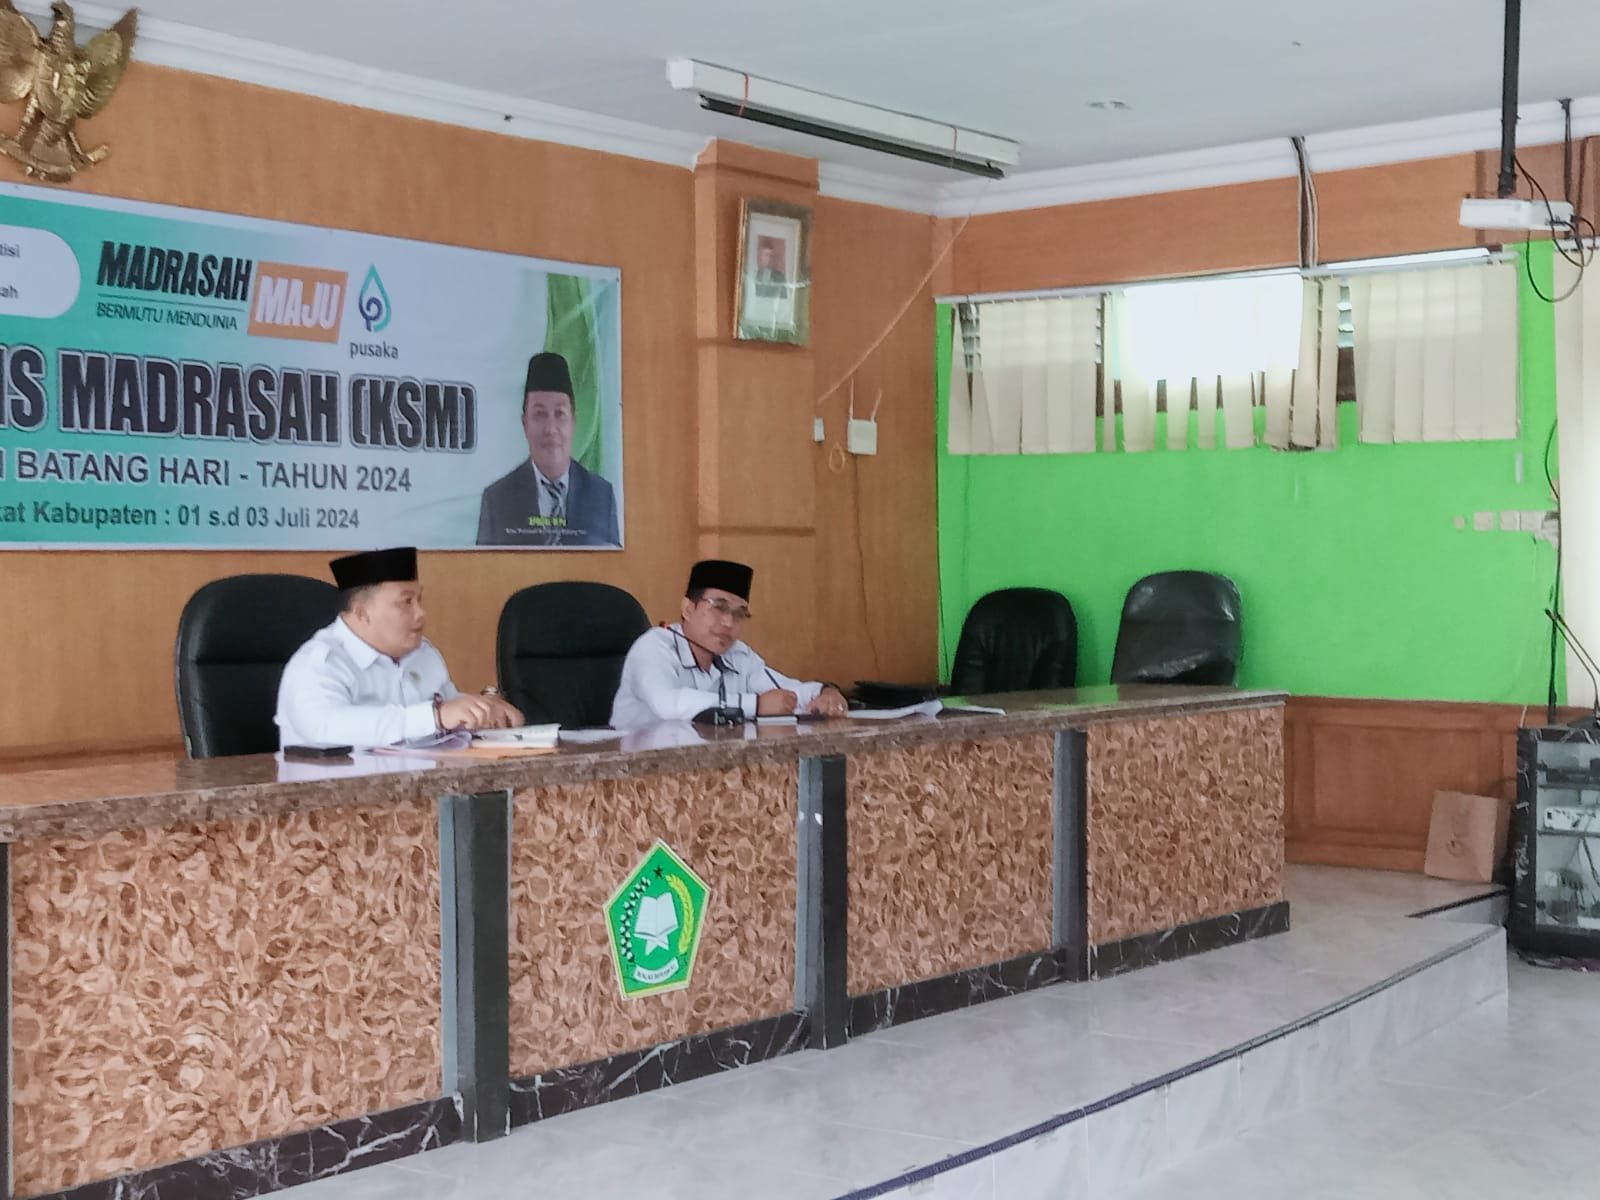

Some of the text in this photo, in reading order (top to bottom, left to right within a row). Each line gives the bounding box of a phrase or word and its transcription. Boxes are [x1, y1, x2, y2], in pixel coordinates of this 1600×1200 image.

[97, 240, 341, 330] MADRASAH MAJU
[97, 302, 238, 330] BERMUTU MENDUNIA
[350, 341, 399, 359] pusaka
[58, 350, 340, 447] MADRASAH
[350, 373, 477, 453] (KSM)
[17, 450, 149, 483] BATANG
[159, 456, 230, 487] HARI
[256, 460, 348, 490] TAHUN
[356, 465, 412, 493] 2024
[33, 500, 157, 529] Kabupaten
[178, 504, 201, 526] 01
[209, 506, 239, 527] s.d
[246, 507, 269, 528] 03
[275, 506, 310, 529] Juli
[316, 508, 360, 529] 2024
